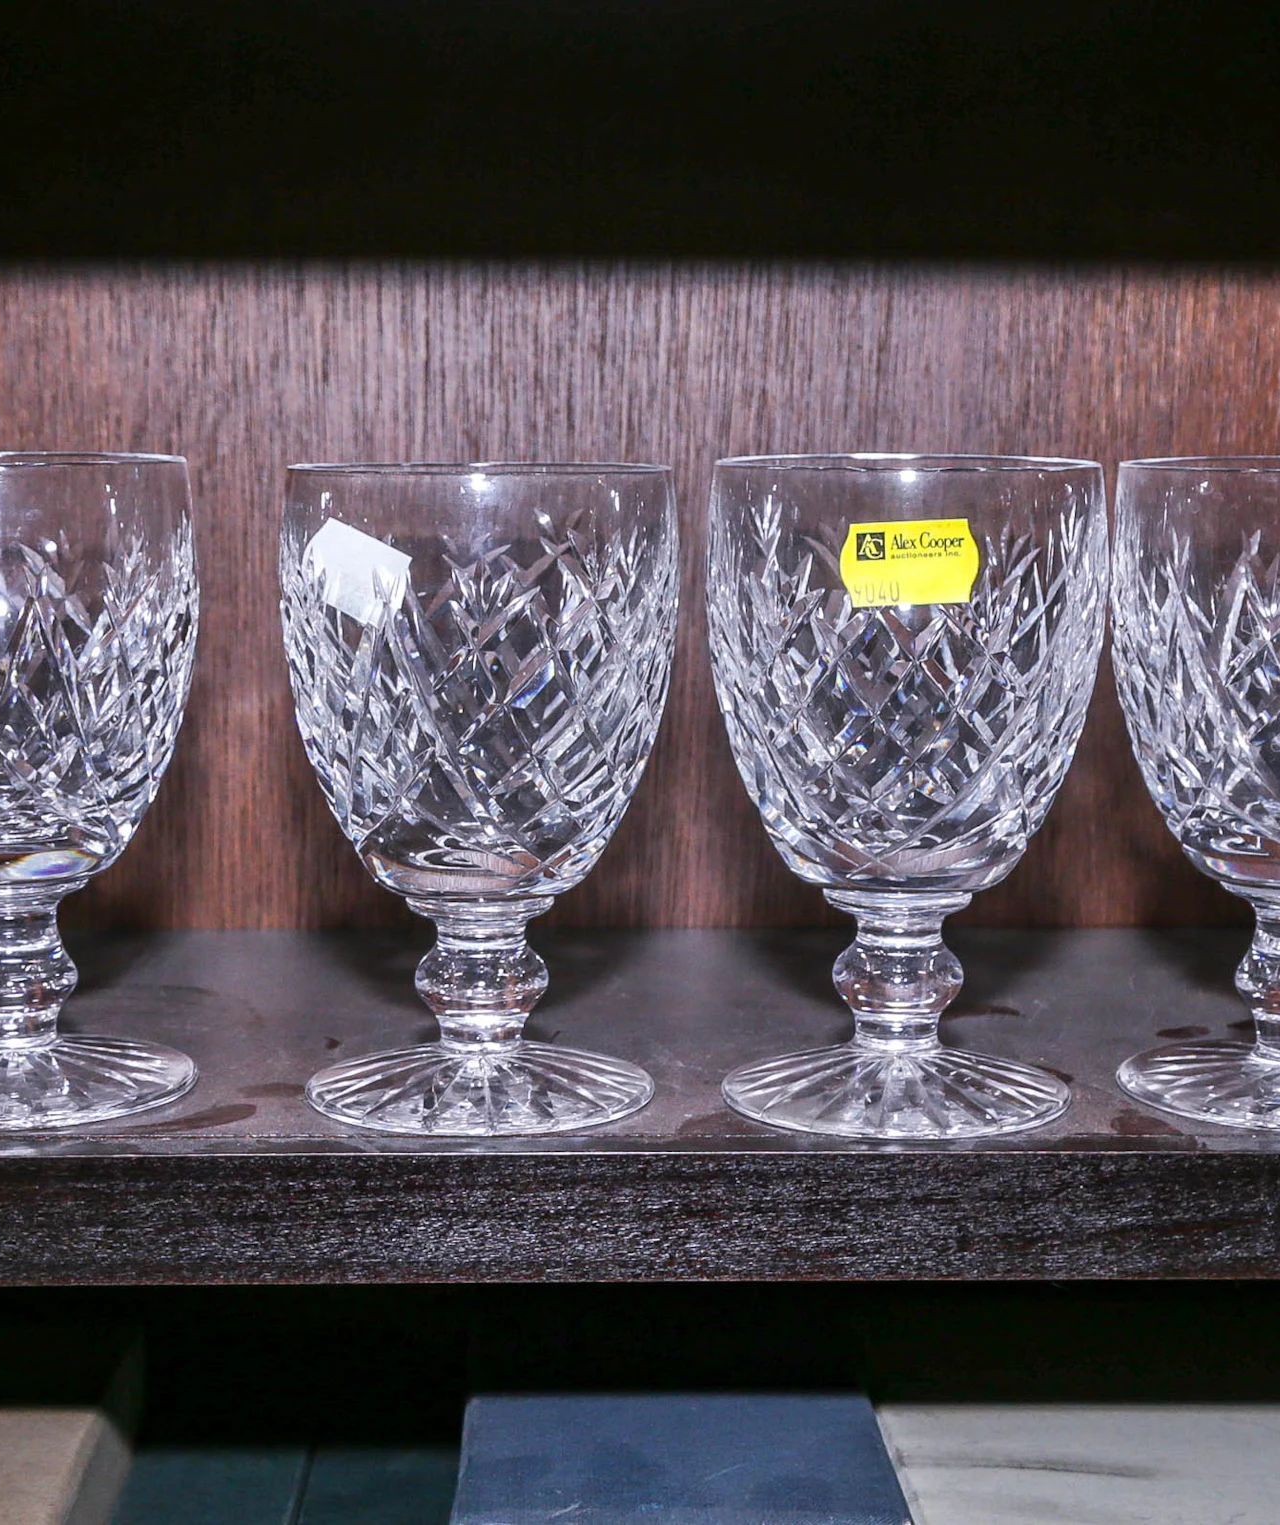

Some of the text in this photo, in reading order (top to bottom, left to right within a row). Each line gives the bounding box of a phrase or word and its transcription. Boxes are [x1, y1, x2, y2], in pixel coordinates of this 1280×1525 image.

[891, 532, 965, 551] Alex Cooper
[890, 551, 942, 559] auctioneers
